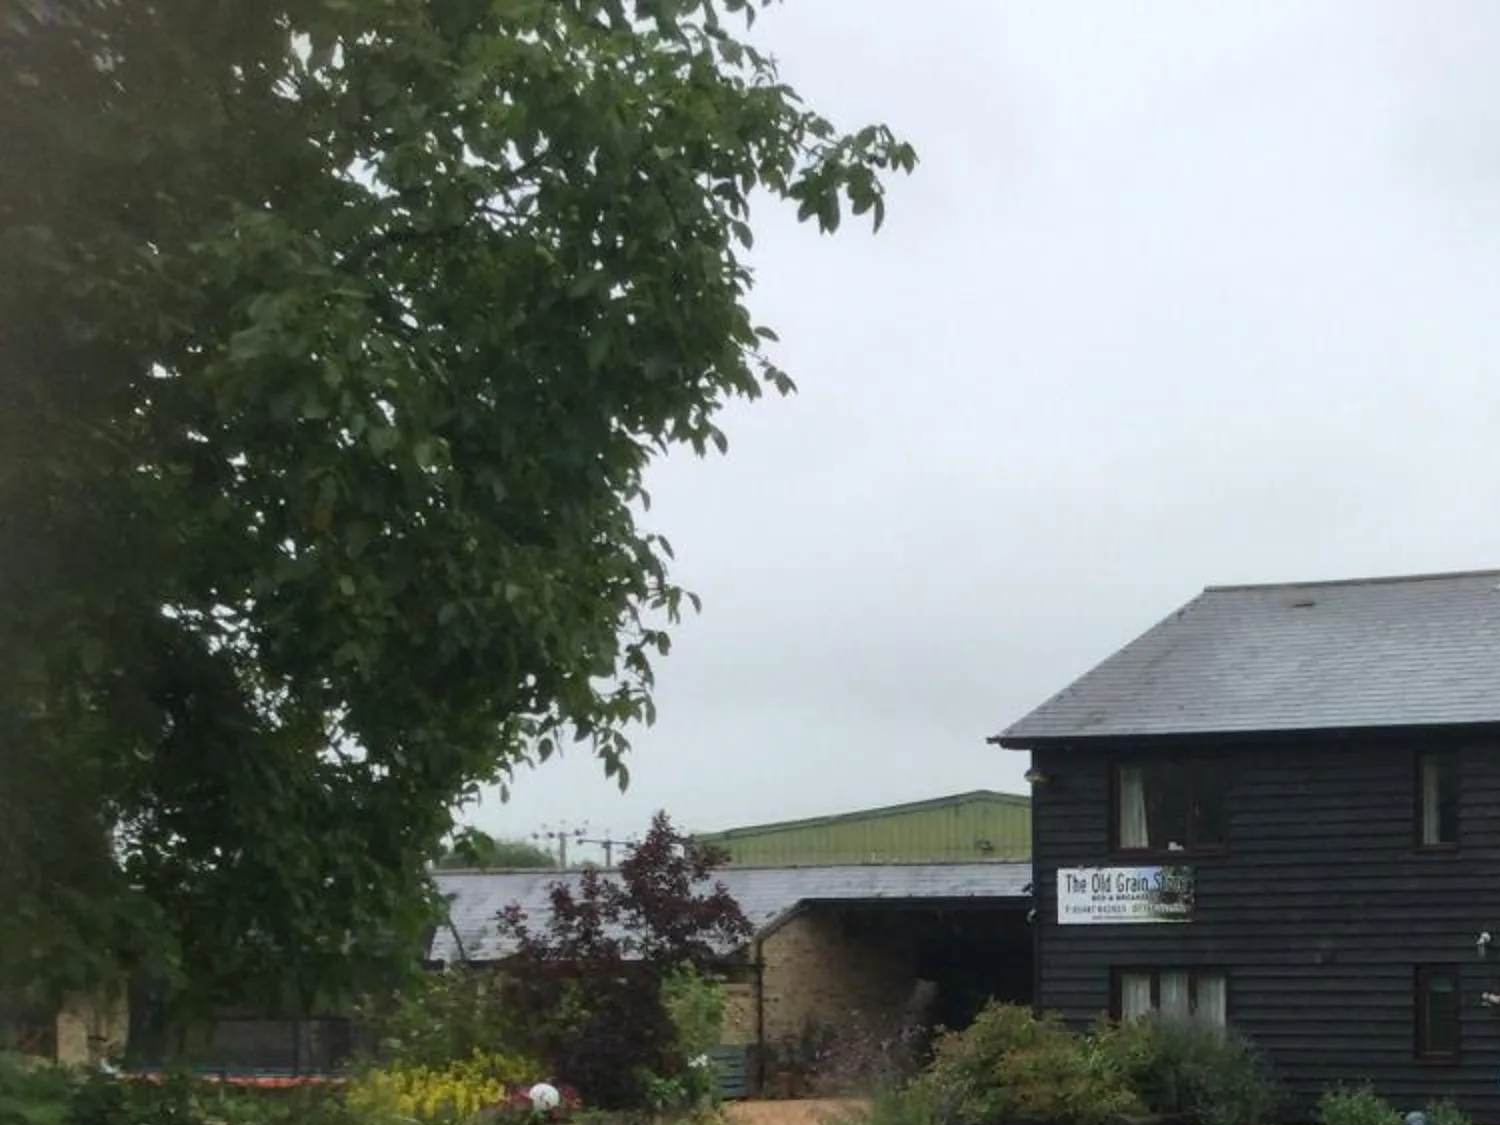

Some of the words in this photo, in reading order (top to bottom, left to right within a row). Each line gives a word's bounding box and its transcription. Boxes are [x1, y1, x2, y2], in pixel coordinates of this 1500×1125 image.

[1066, 873, 1087, 894] The
[1091, 873, 1113, 893] Old
[1116, 872, 1150, 893] Grain
